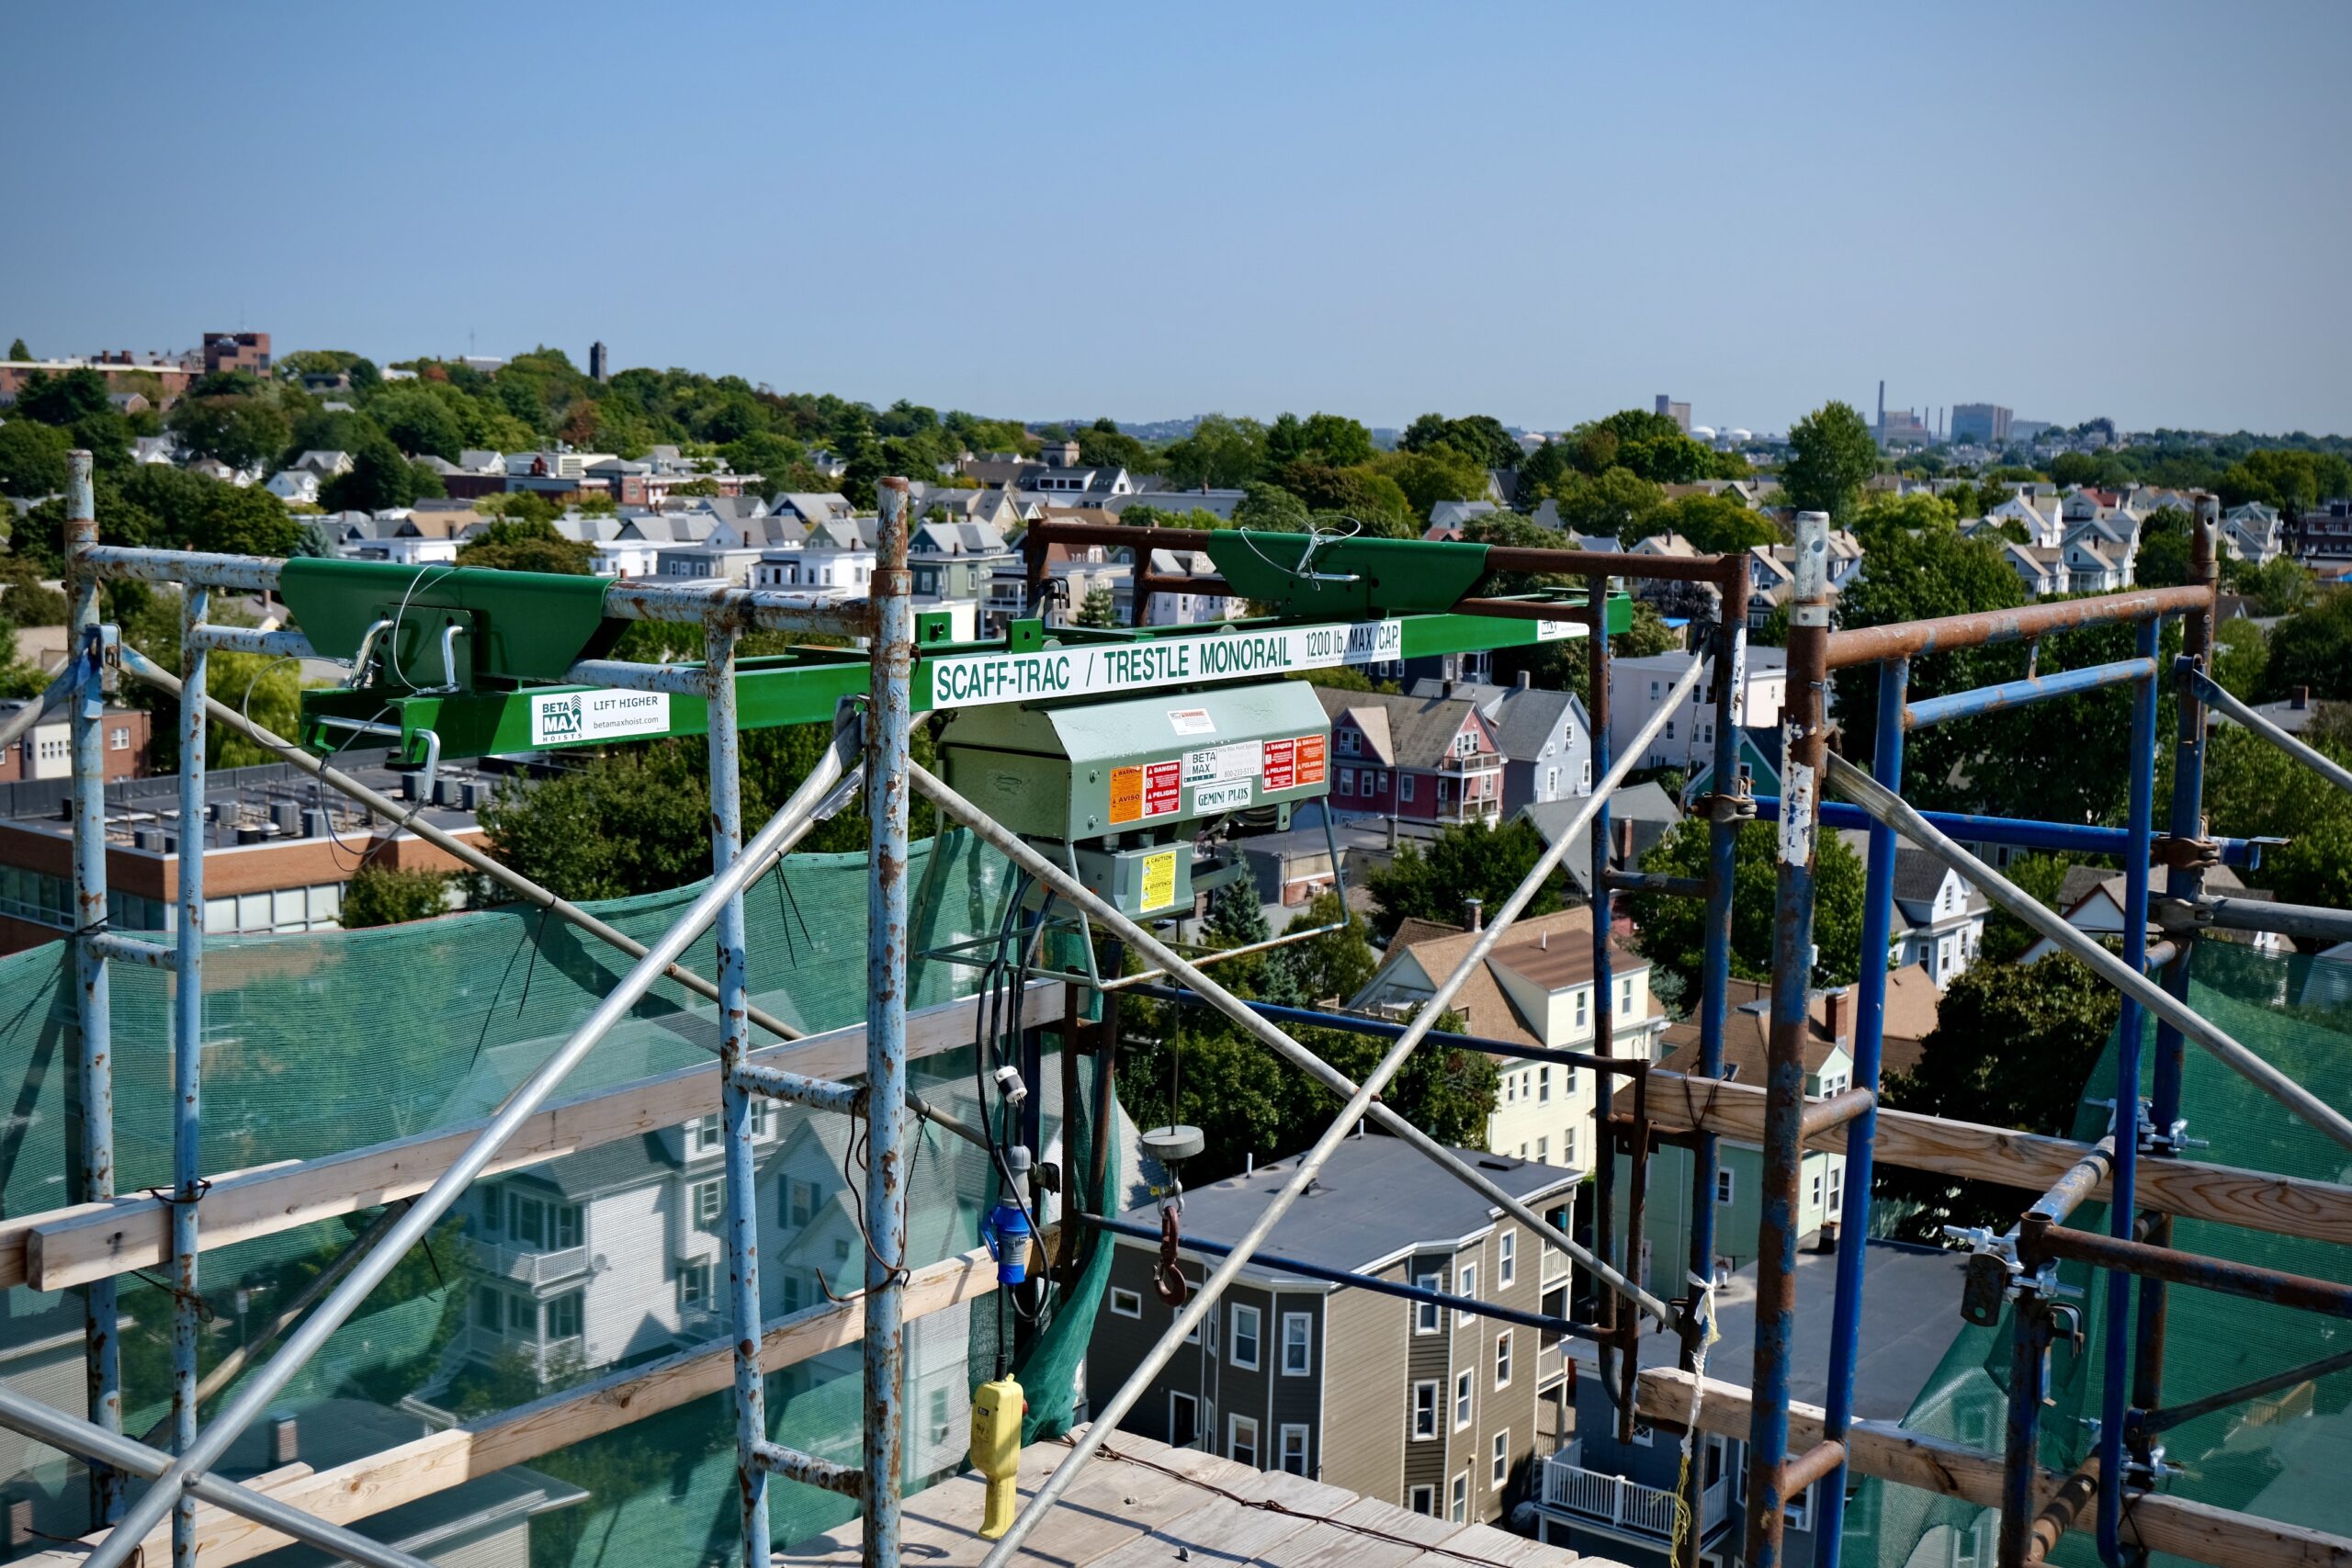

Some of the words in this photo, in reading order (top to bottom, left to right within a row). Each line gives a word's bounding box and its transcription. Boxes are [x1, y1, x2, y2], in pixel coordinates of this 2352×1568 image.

[937, 656, 1070, 702] SCAFF-TRAC
[1086, 652, 1094, 687] /
[1104, 645, 1190, 684] TRESTLE
[1200, 637, 1292, 674] MONORAIL
[1306, 630, 1330, 657] 1200
[1334, 630, 1346, 654] lb.
[1349, 626, 1375, 653] MAX.
[1379, 625, 1398, 649] CAP.
[542, 702, 570, 713] BETA
[594, 700, 616, 711] LIFT
[619, 696, 659, 708] HIGHER
[543, 711, 582, 733] MAX
[594, 716, 659, 729] betamaxhoist.com
[543, 733, 582, 742] HOISTS
[1193, 751, 1216, 763] BETA
[1154, 764, 1178, 773] DANGER
[1193, 763, 1210, 774] MAX
[1119, 794, 1139, 803] AVISO
[1152, 789, 1178, 797] PELIGRO
[1198, 791, 1224, 807] GEMINI
[1227, 788, 1249, 801] PLUS
